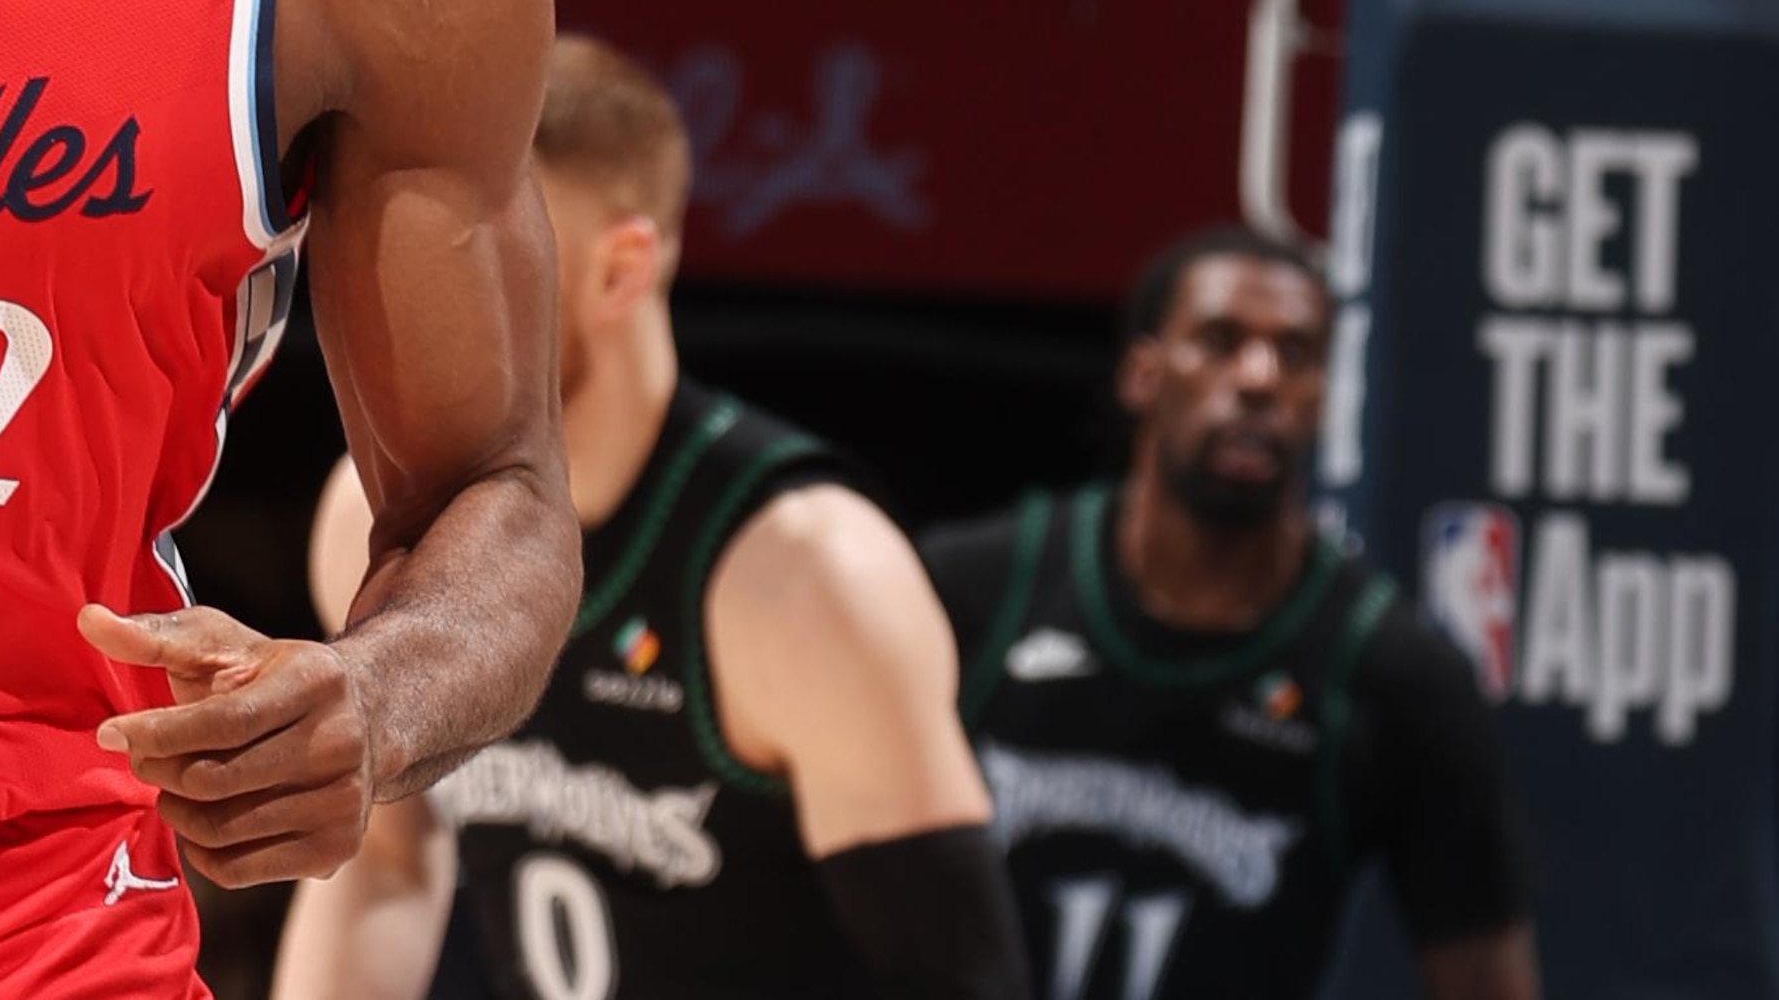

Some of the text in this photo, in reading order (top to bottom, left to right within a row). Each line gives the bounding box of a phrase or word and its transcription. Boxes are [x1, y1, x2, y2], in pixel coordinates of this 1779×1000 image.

[1482, 121, 1698, 313] GET
[1478, 317, 1696, 502] THE
[1522, 511, 1736, 744] App
[515, 850, 622, 1000] 0
